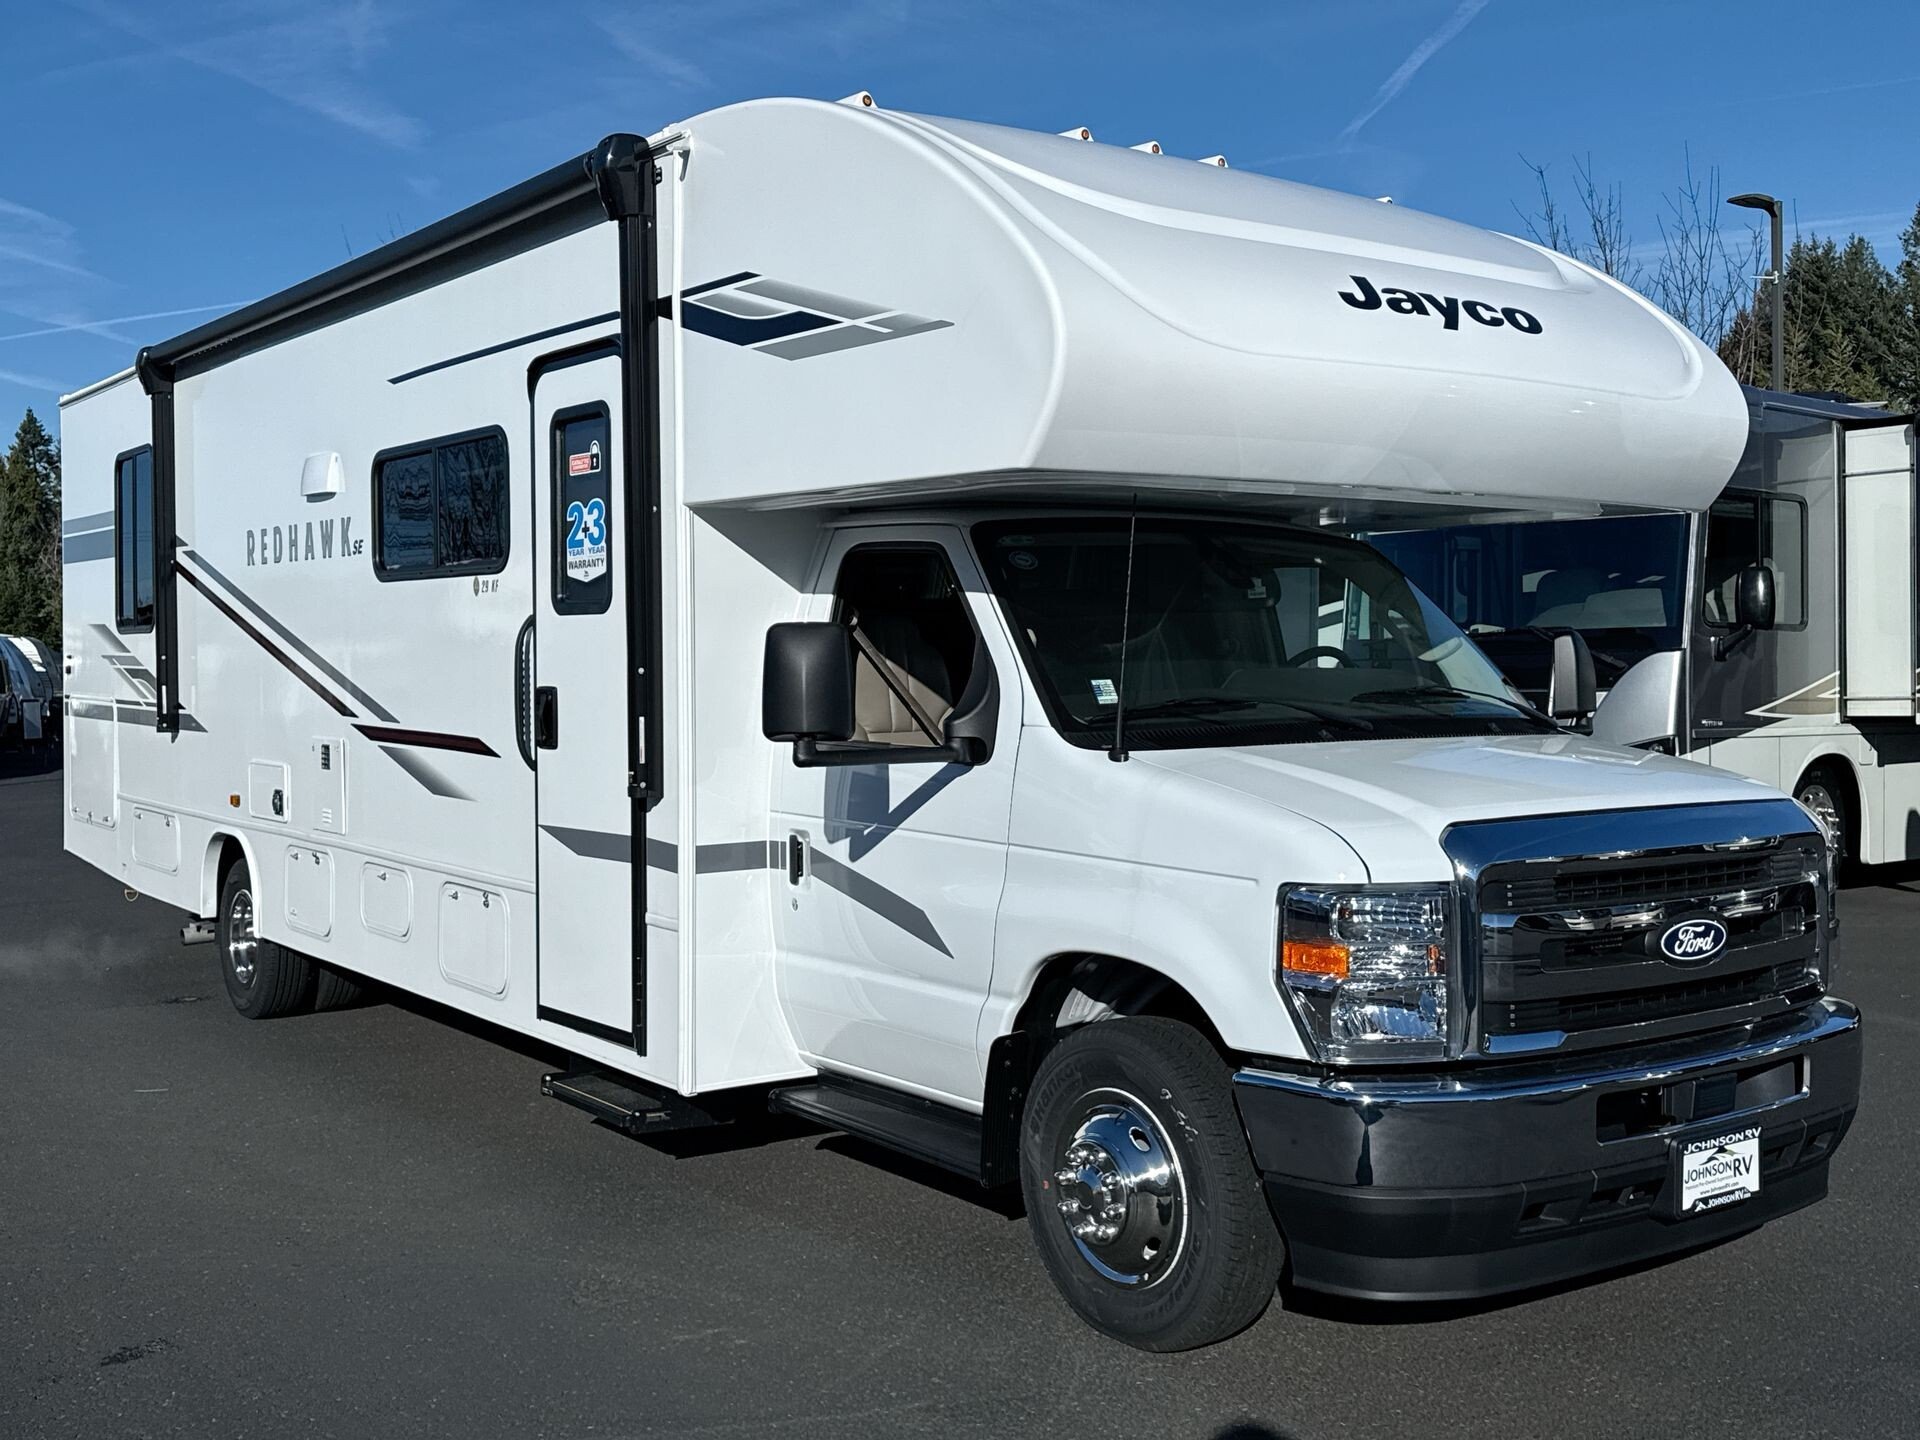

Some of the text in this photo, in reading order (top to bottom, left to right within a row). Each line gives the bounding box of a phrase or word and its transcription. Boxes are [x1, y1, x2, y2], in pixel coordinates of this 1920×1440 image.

[1337, 274, 1543, 335] Jayco
[246, 516, 364, 566] REDHAWK SE
[568, 545, 605, 557] YEAR YEAR
[568, 558, 605, 570] WARRANTY
[1674, 925, 1715, 954] Ford
